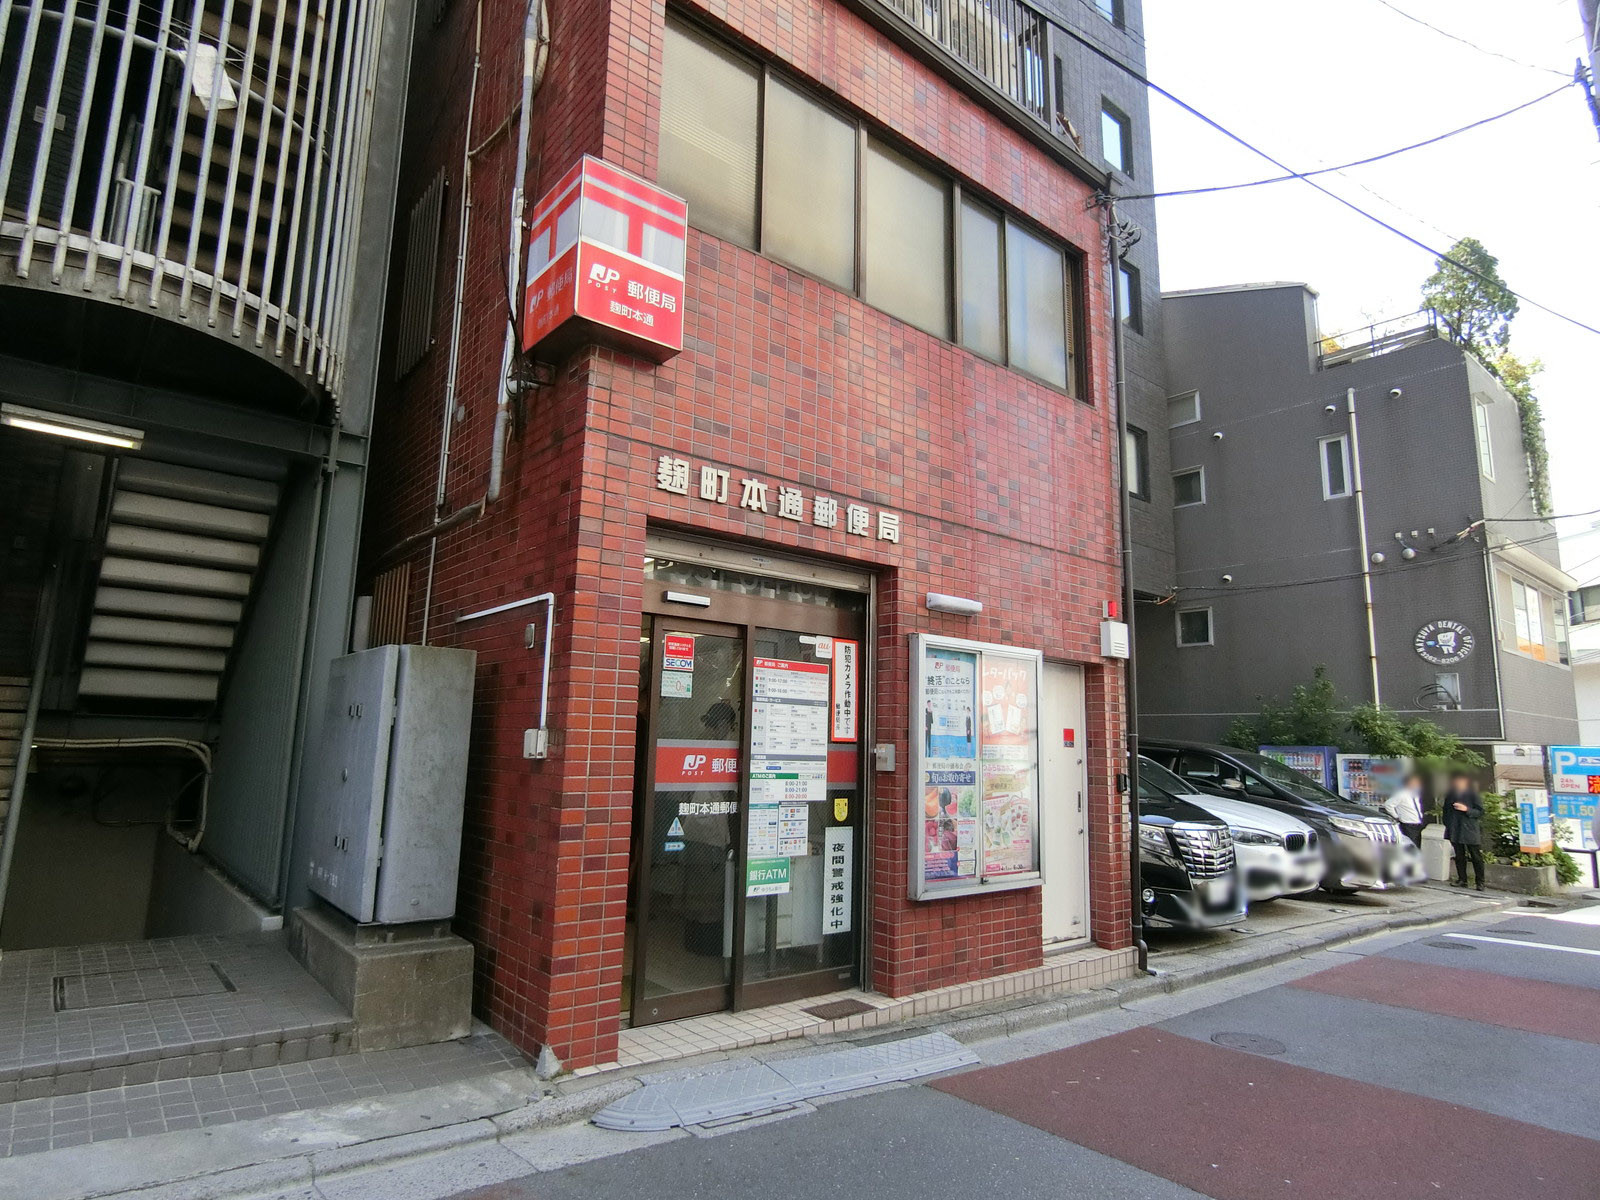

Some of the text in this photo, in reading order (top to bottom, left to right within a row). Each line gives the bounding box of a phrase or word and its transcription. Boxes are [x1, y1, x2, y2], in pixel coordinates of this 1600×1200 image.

[627, 280, 676, 313] 郵便局
[610, 301, 654, 327] 麹町本通
[657, 455, 899, 544] 麹町本通郵便局
[1438, 620, 1465, 634] DENTAL
[1456, 635, 1473, 658] OFFICE
[666, 659, 692, 667] SECOM
[749, 867, 787, 881] 銀行ATM
[830, 842, 845, 929] 夜間警戒強化中
